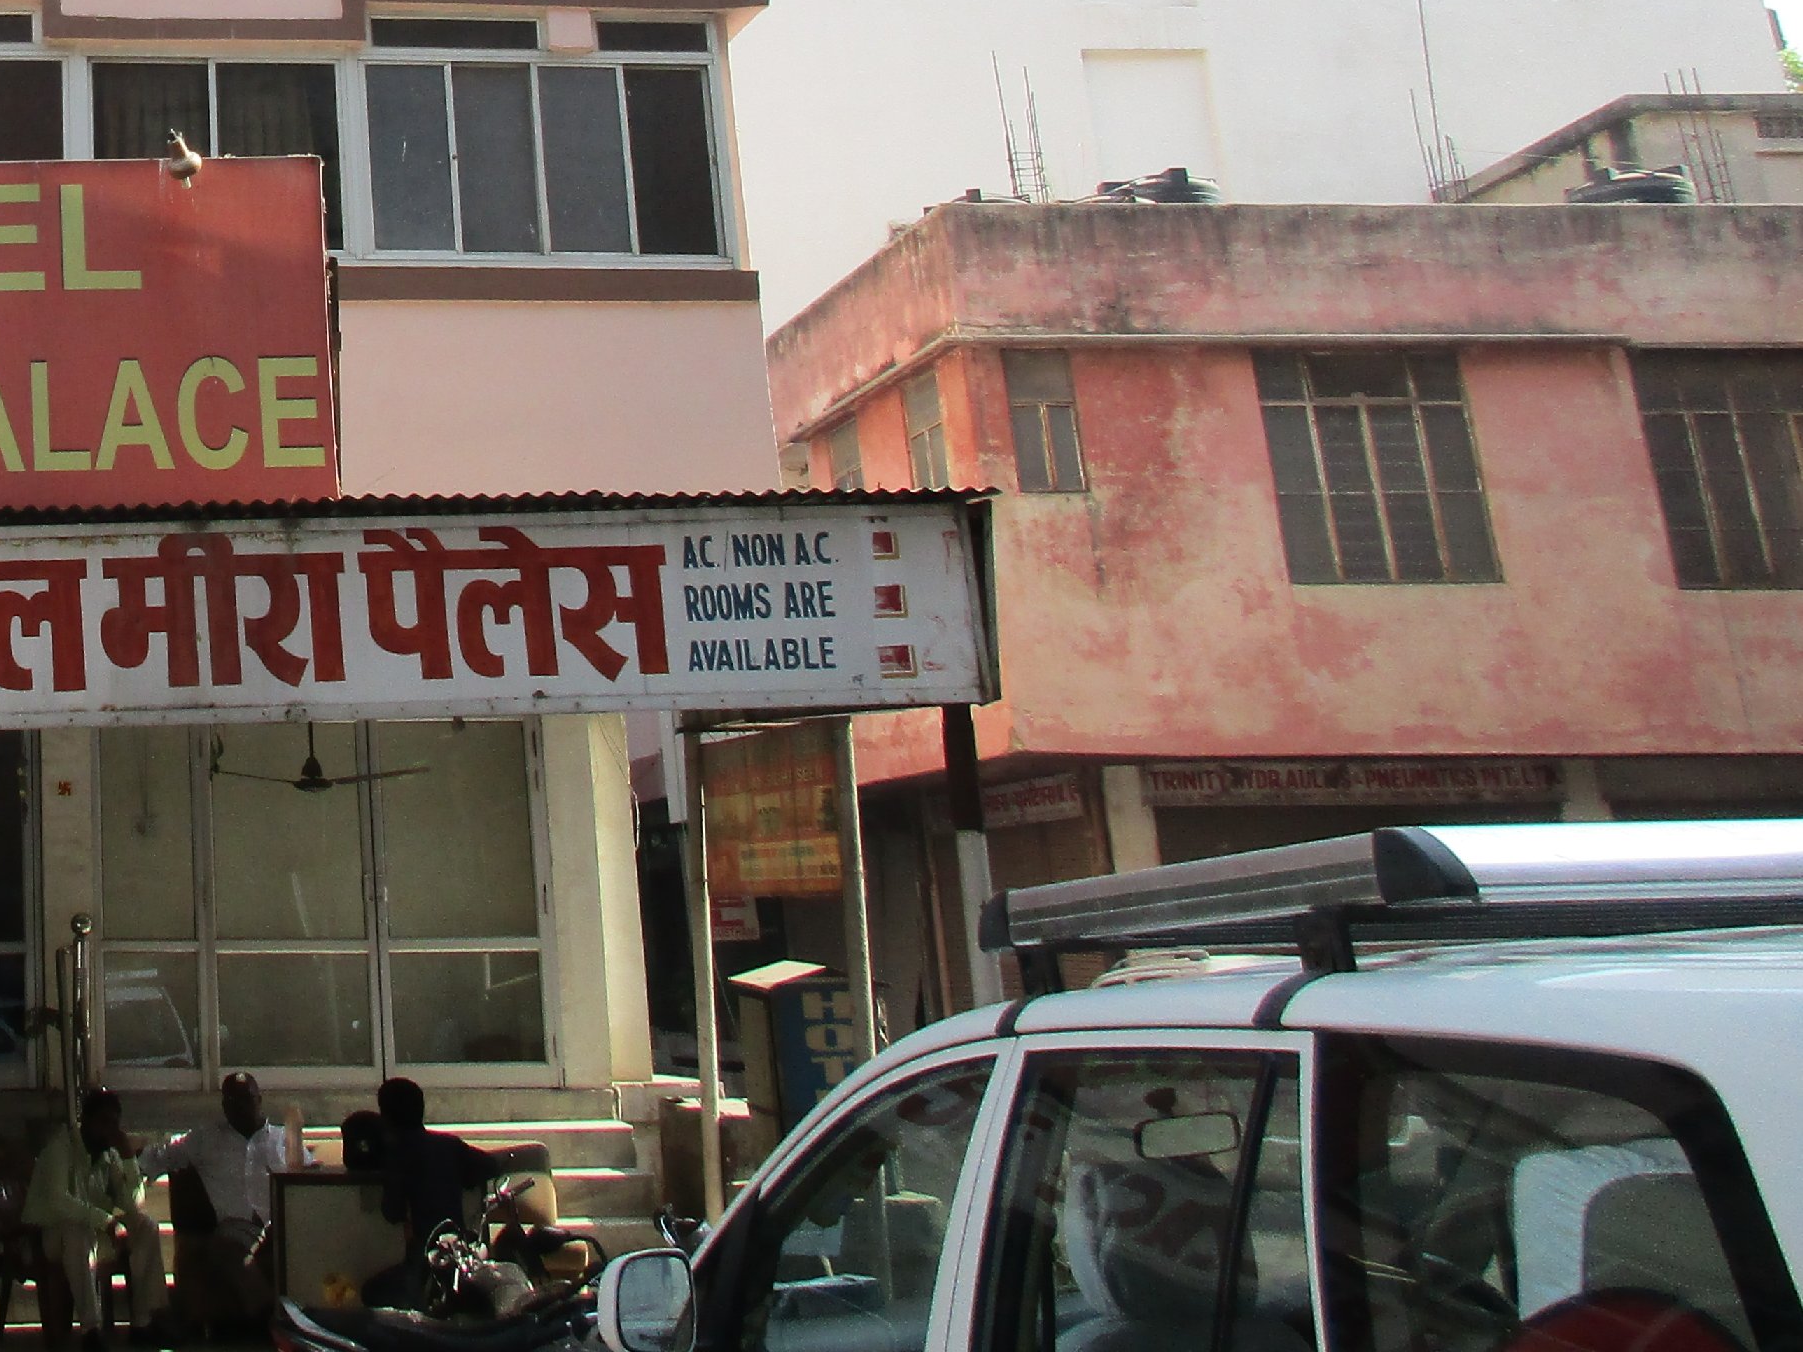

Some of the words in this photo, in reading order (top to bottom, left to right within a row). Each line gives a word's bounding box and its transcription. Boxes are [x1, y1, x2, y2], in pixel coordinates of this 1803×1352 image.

[794, 531, 839, 566] A.C.
[100, 533, 346, 687] मीरा
[357, 525, 670, 682] पैलेस
[683, 582, 772, 622] ROOMS
[784, 580, 837, 619] ARE
[688, 636, 837, 672] AVAILABLE
[801, 991, 854, 1103] HOT
